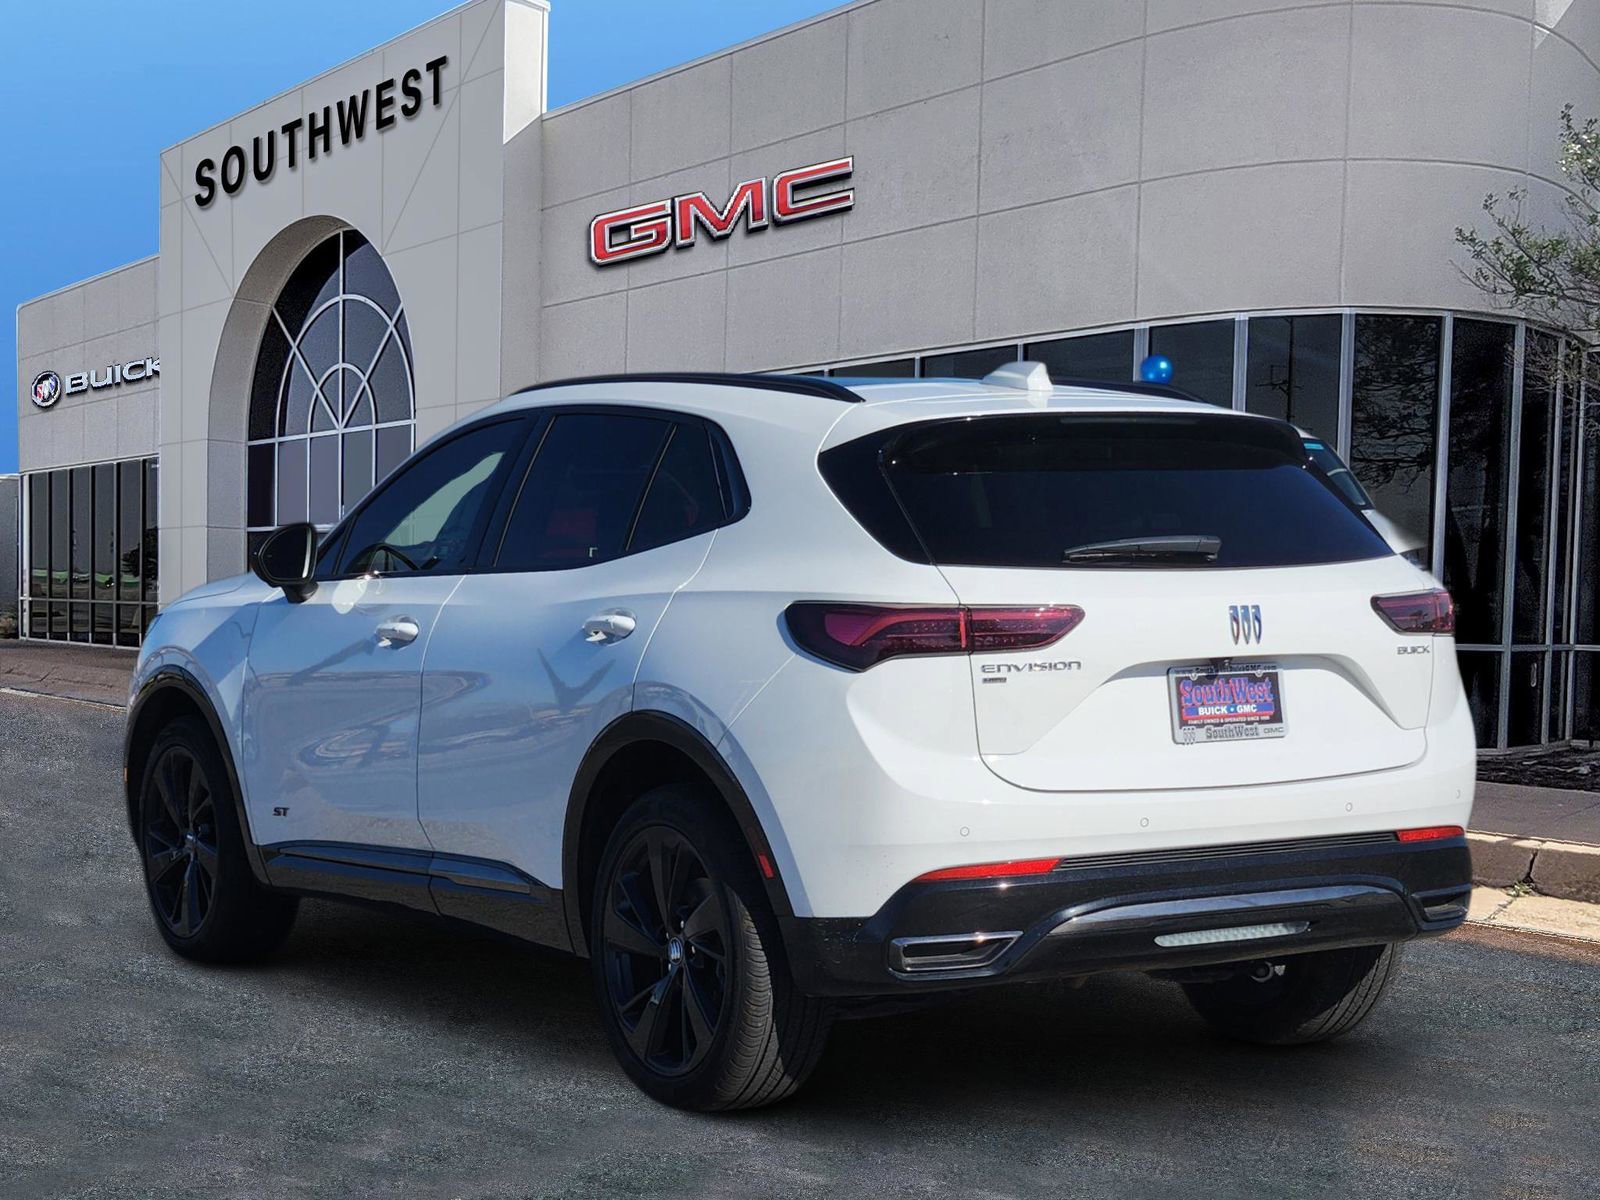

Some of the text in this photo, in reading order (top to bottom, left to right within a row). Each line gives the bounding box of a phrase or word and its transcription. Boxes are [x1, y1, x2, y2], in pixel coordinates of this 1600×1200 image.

[194, 55, 448, 208] SOUTHWEST
[589, 156, 855, 266] GMC
[65, 357, 160, 394] BUICK
[1397, 645, 1431, 655] BUICK
[981, 660, 1082, 674] ENVISION
[1180, 677, 1274, 705] SouthWest
[1198, 704, 1258, 715] BUICK GMC
[1205, 725, 1260, 740] SouthWest
[272, 807, 290, 817] ST
